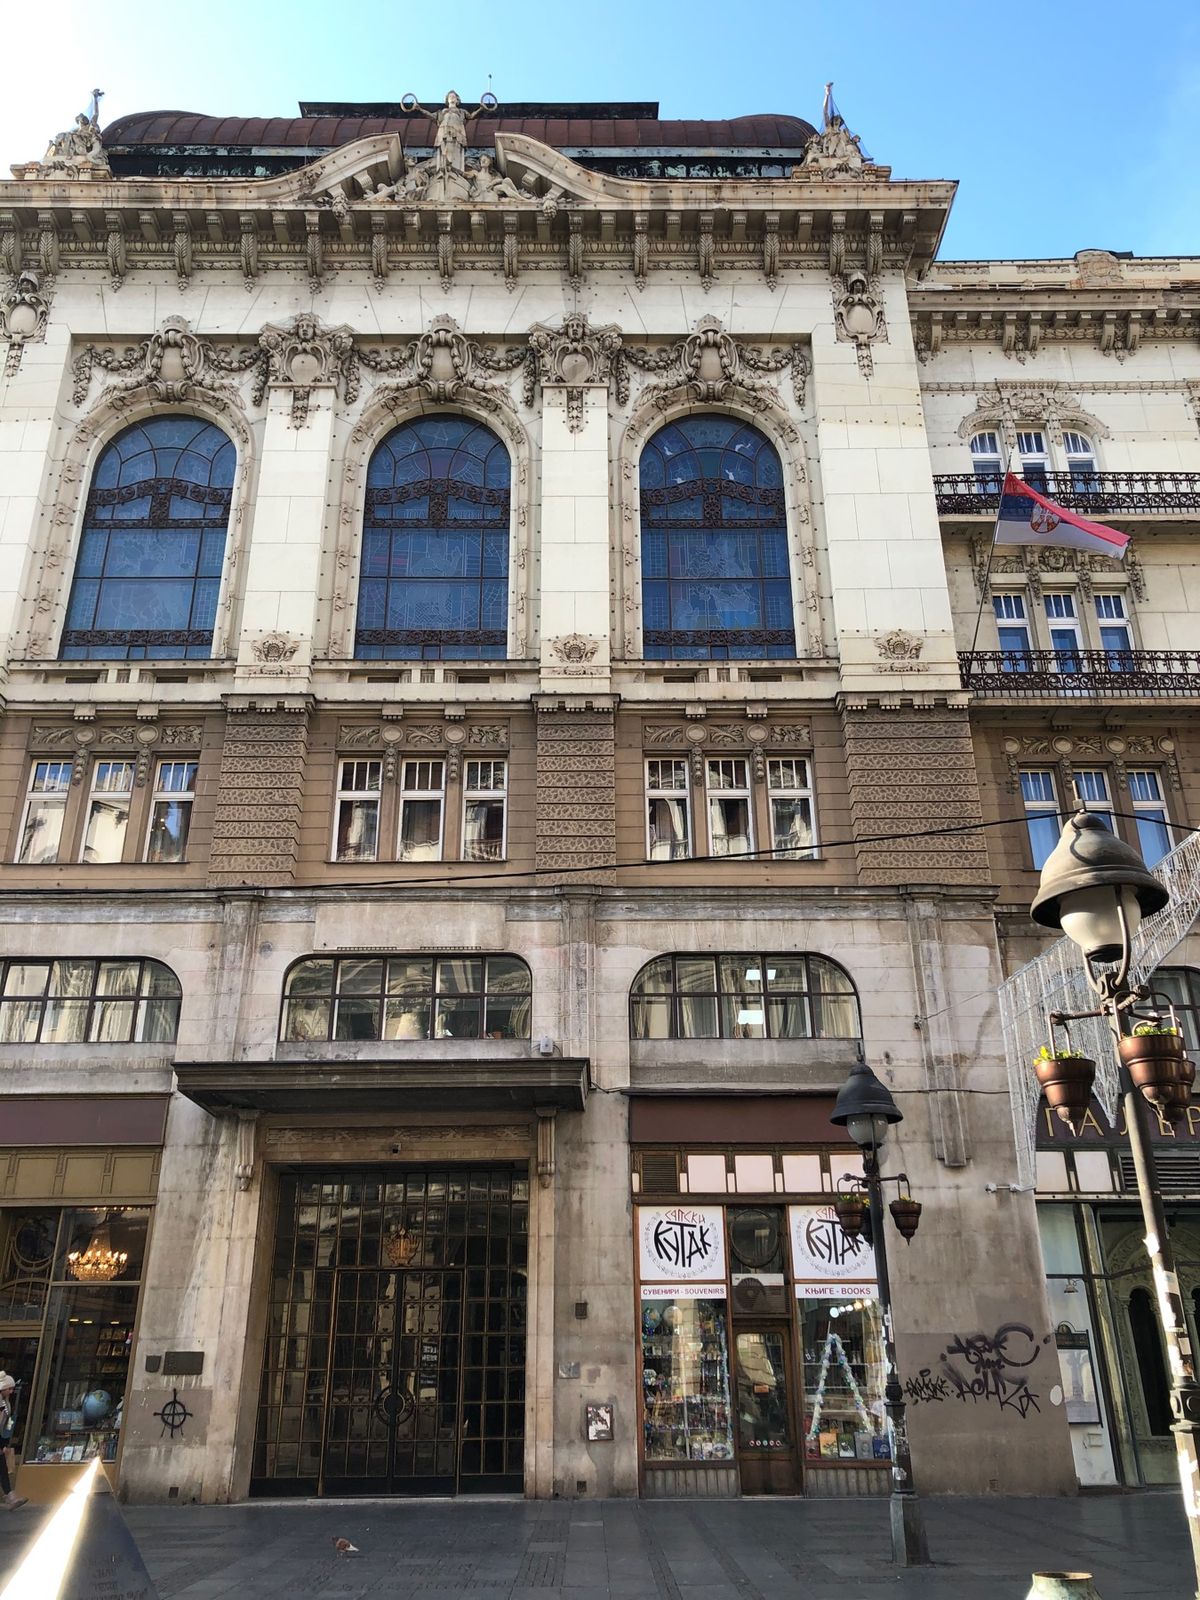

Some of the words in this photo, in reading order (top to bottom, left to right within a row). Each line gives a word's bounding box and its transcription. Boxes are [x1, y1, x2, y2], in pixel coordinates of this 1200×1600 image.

[654, 1220, 712, 1267] КУТАК
[643, 1288, 680, 1296] СУВЕНИРИ
[805, 1287, 835, 1295] КЊИГЕ
[841, 1287, 871, 1295] BOOKS
